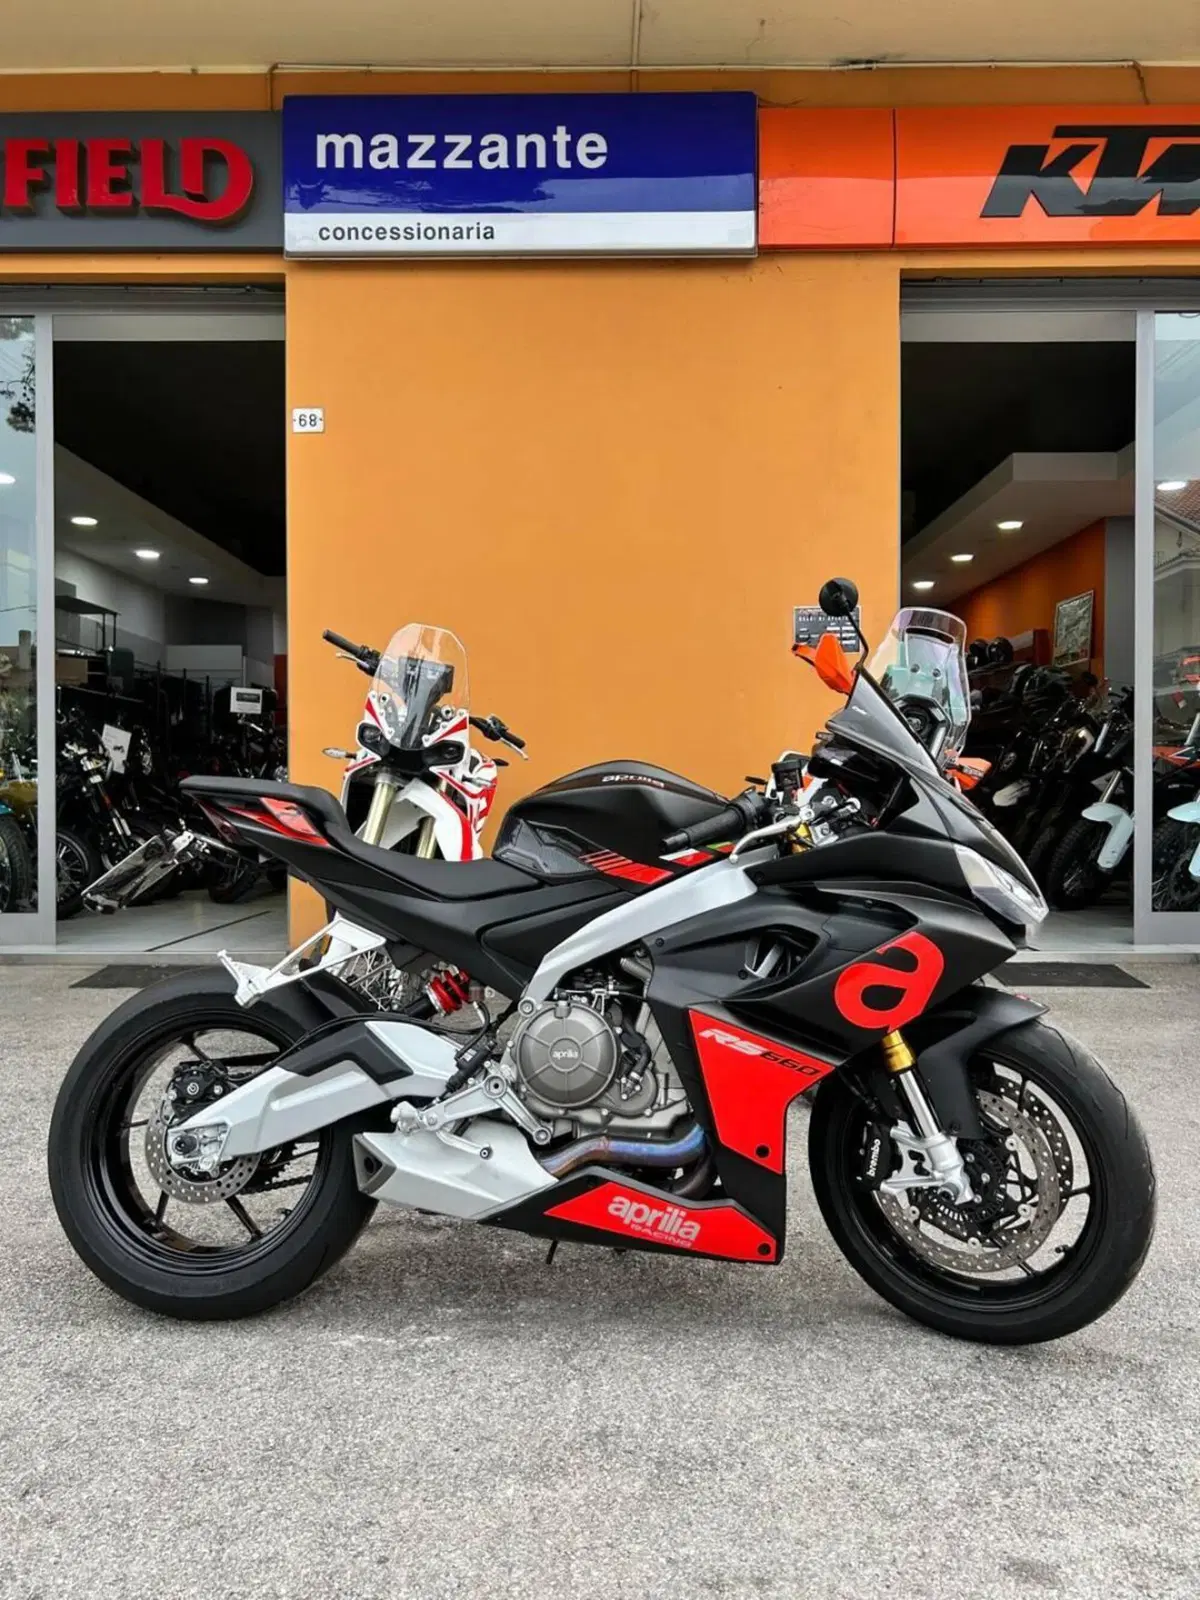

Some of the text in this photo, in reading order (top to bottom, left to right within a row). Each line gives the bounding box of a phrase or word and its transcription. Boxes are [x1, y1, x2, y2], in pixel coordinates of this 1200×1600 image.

[315, 125, 608, 170] mazzante
[318, 222, 495, 241] concessionaria
[298, 413, 317, 428] 68
[552, 1049, 579, 1060] aprilia
[698, 1028, 769, 1056] RS
[866, 1138, 881, 1177] brembo
[607, 1195, 701, 1242] aprilia
